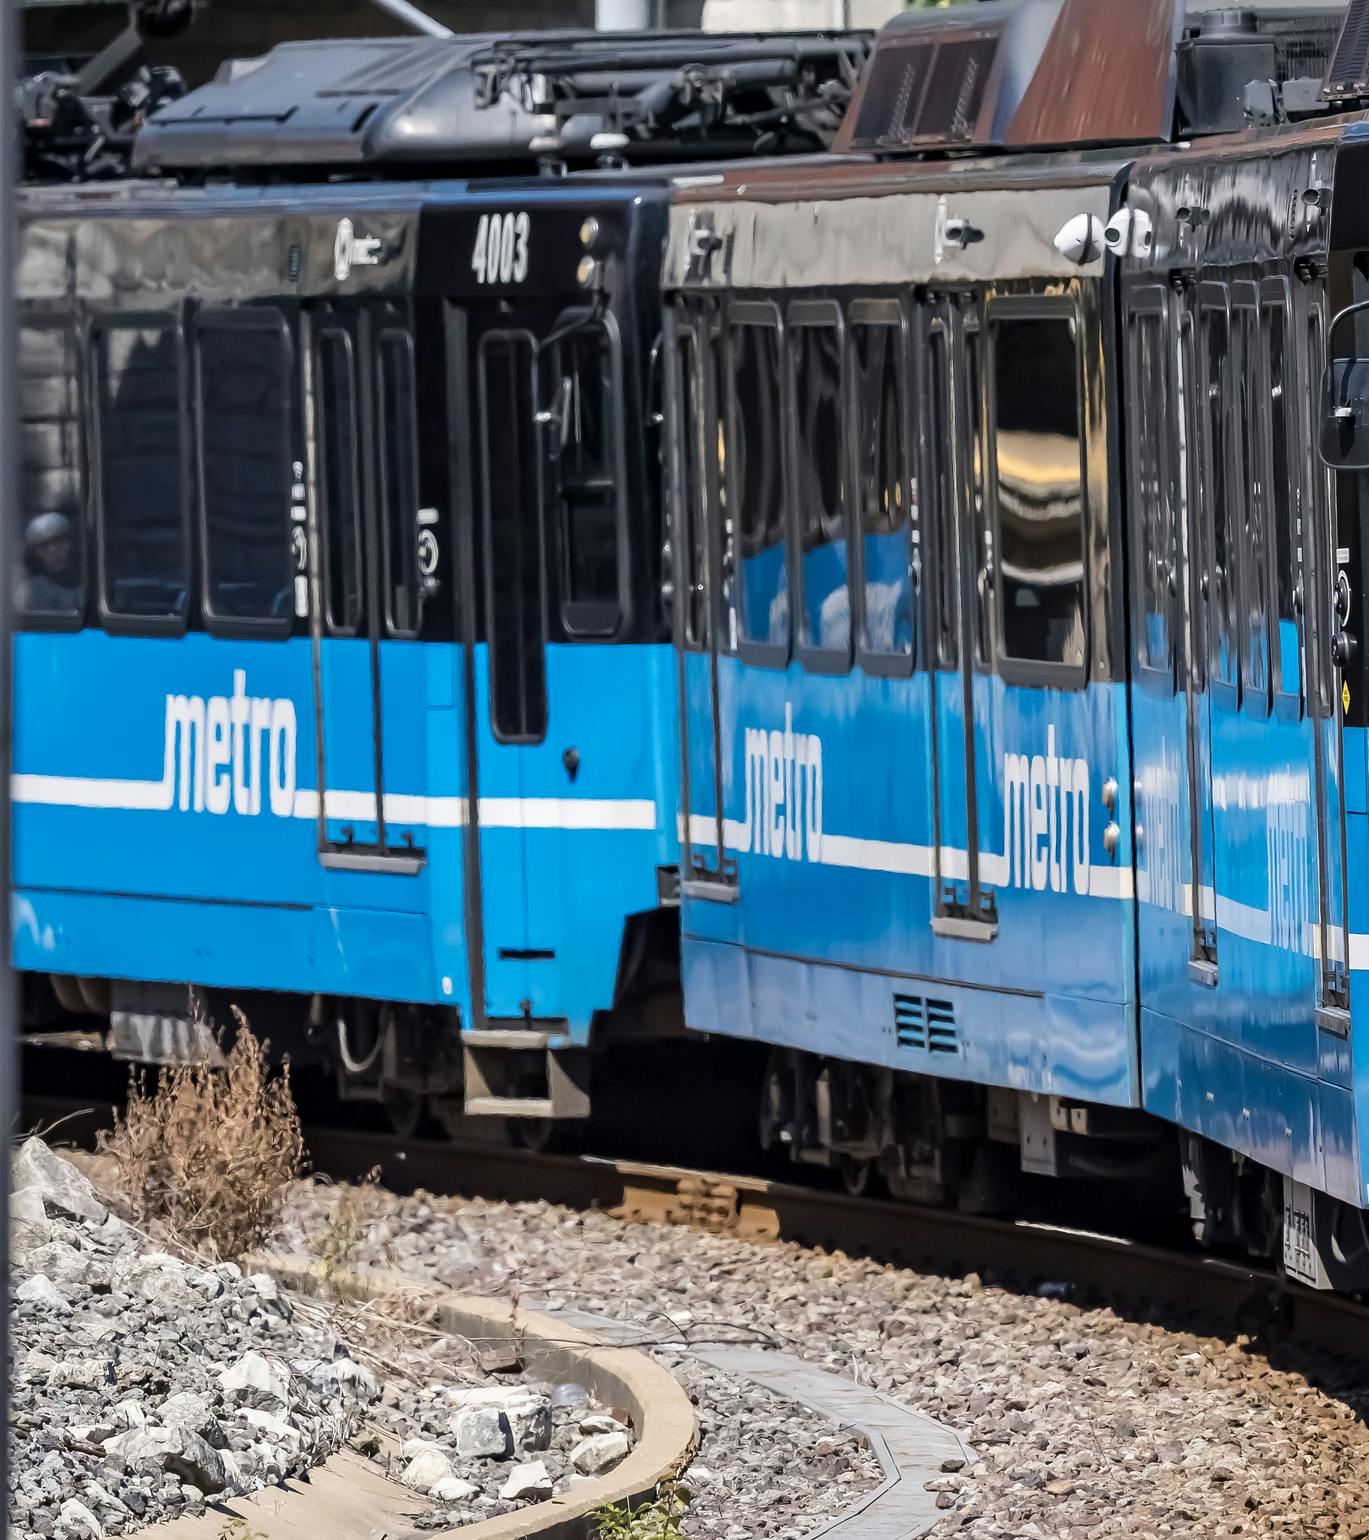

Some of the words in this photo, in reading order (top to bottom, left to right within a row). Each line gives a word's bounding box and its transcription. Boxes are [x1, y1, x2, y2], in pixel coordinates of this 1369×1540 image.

[472, 211, 530, 284] 4003
[165, 668, 297, 817] metro
[744, 701, 823, 863] metro
[1003, 723, 1090, 895] metro
